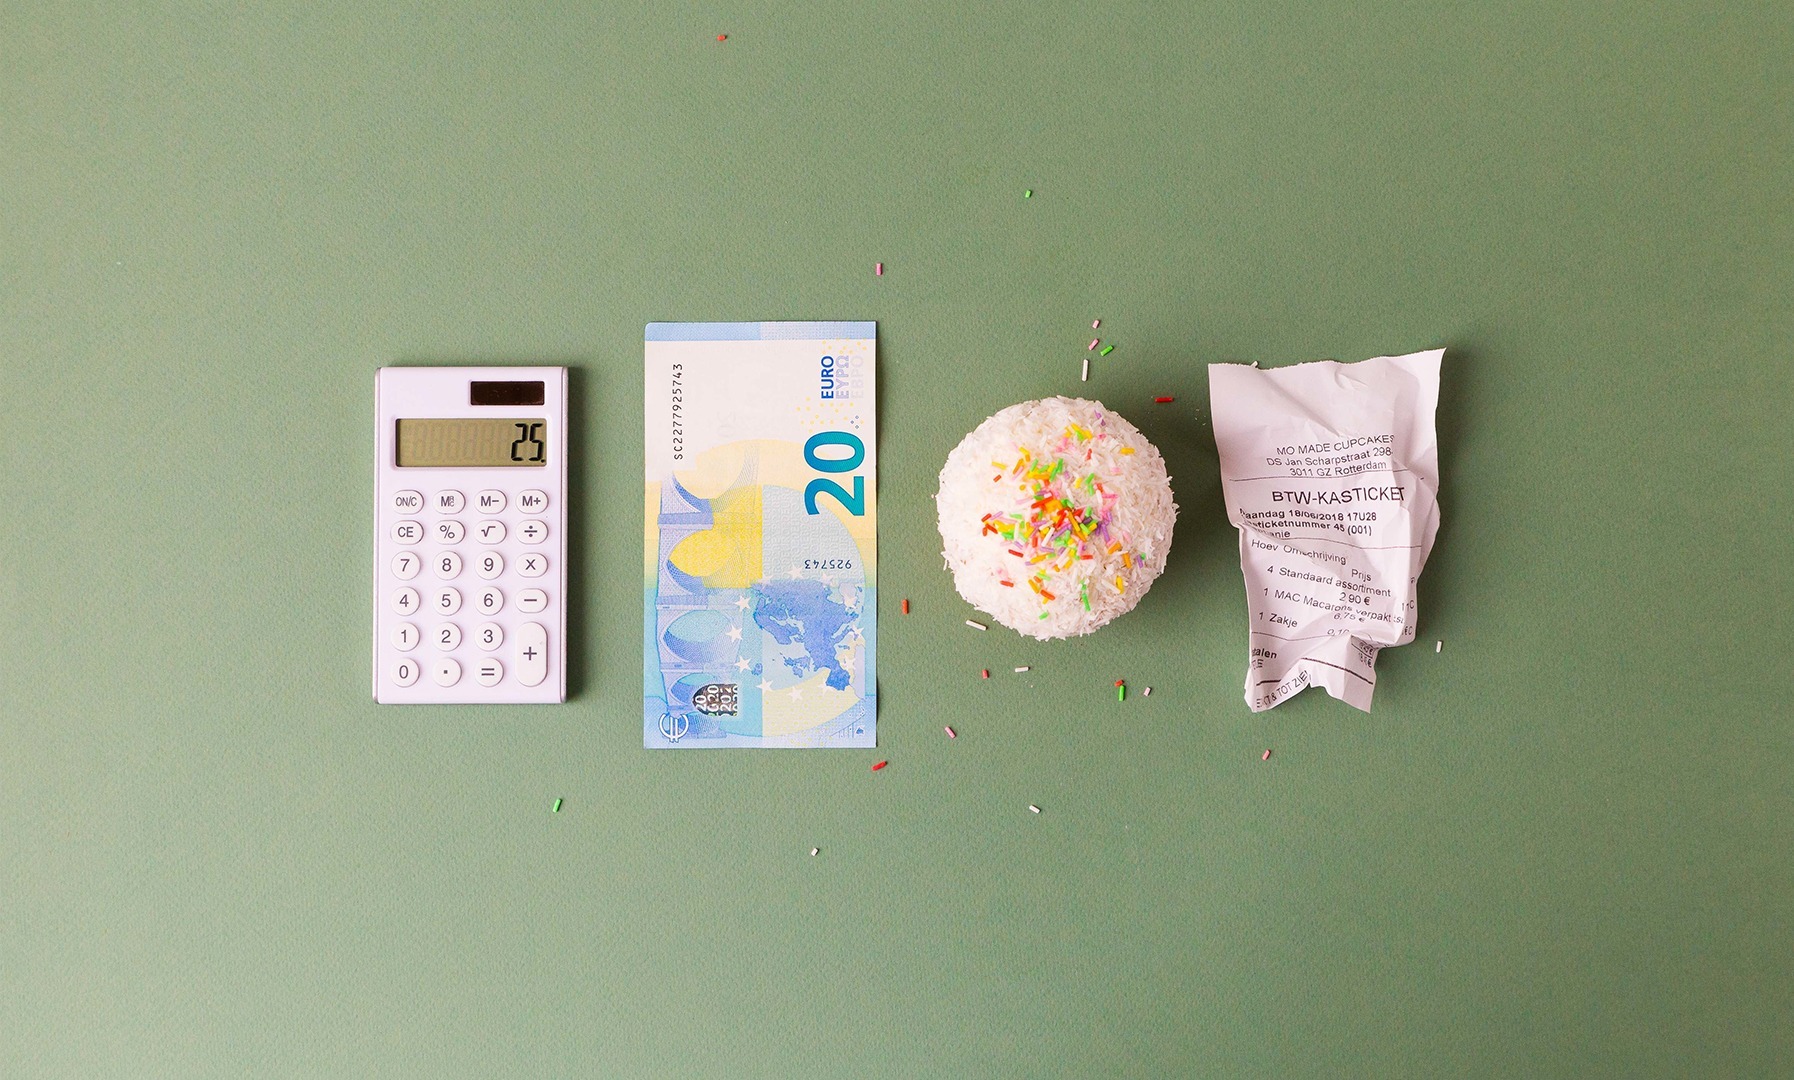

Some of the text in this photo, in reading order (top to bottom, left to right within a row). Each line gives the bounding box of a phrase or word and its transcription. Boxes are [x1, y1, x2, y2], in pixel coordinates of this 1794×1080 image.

[821, 355, 834, 399] EURO
[672, 363, 683, 460] SC2277925743
[1277, 446, 1295, 455] MO
[1298, 443, 1330, 454] MADE
[1285, 458, 1302, 466] Jan
[1306, 451, 1370, 466] Scharpstraat
[804, 431, 865, 516] 20
[1290, 462, 1386, 476] 3011 GZ Rotterdam
[395, 496, 417, 508] ON/C
[522, 496, 541, 506] M+
[1272, 487, 1405, 504] BTW-KASTICKET
[1289, 510, 1344, 521] 18/06/2018
[1348, 512, 1376, 521] 17U28
[398, 527, 414, 538] CE
[1348, 526, 1371, 536] (001)
[1252, 539, 1278, 551] Hoev
[400, 559, 409, 572] 7
[442, 559, 452, 572] 8
[484, 559, 494, 572] 9
[804, 559, 852, 569] 925743
[1279, 567, 1333, 585] Standaard
[1336, 581, 1391, 597] assortiment
[1352, 569, 1371, 582] Prijs
[399, 595, 409, 607] 4
[442, 595, 451, 607] 5
[484, 595, 494, 607] 6
[1264, 588, 1268, 596] 1
[1275, 590, 1300, 602] MAC
[1303, 596, 1352, 612] Macarons
[1356, 609, 1391, 622] verpakt
[1259, 612, 1298, 628] 1 Zakje
[401, 630, 407, 643] 1
[441, 630, 451, 643] 2
[484, 630, 493, 643] 3
[399, 666, 409, 679] 0
[1276, 682, 1292, 697] TOT
